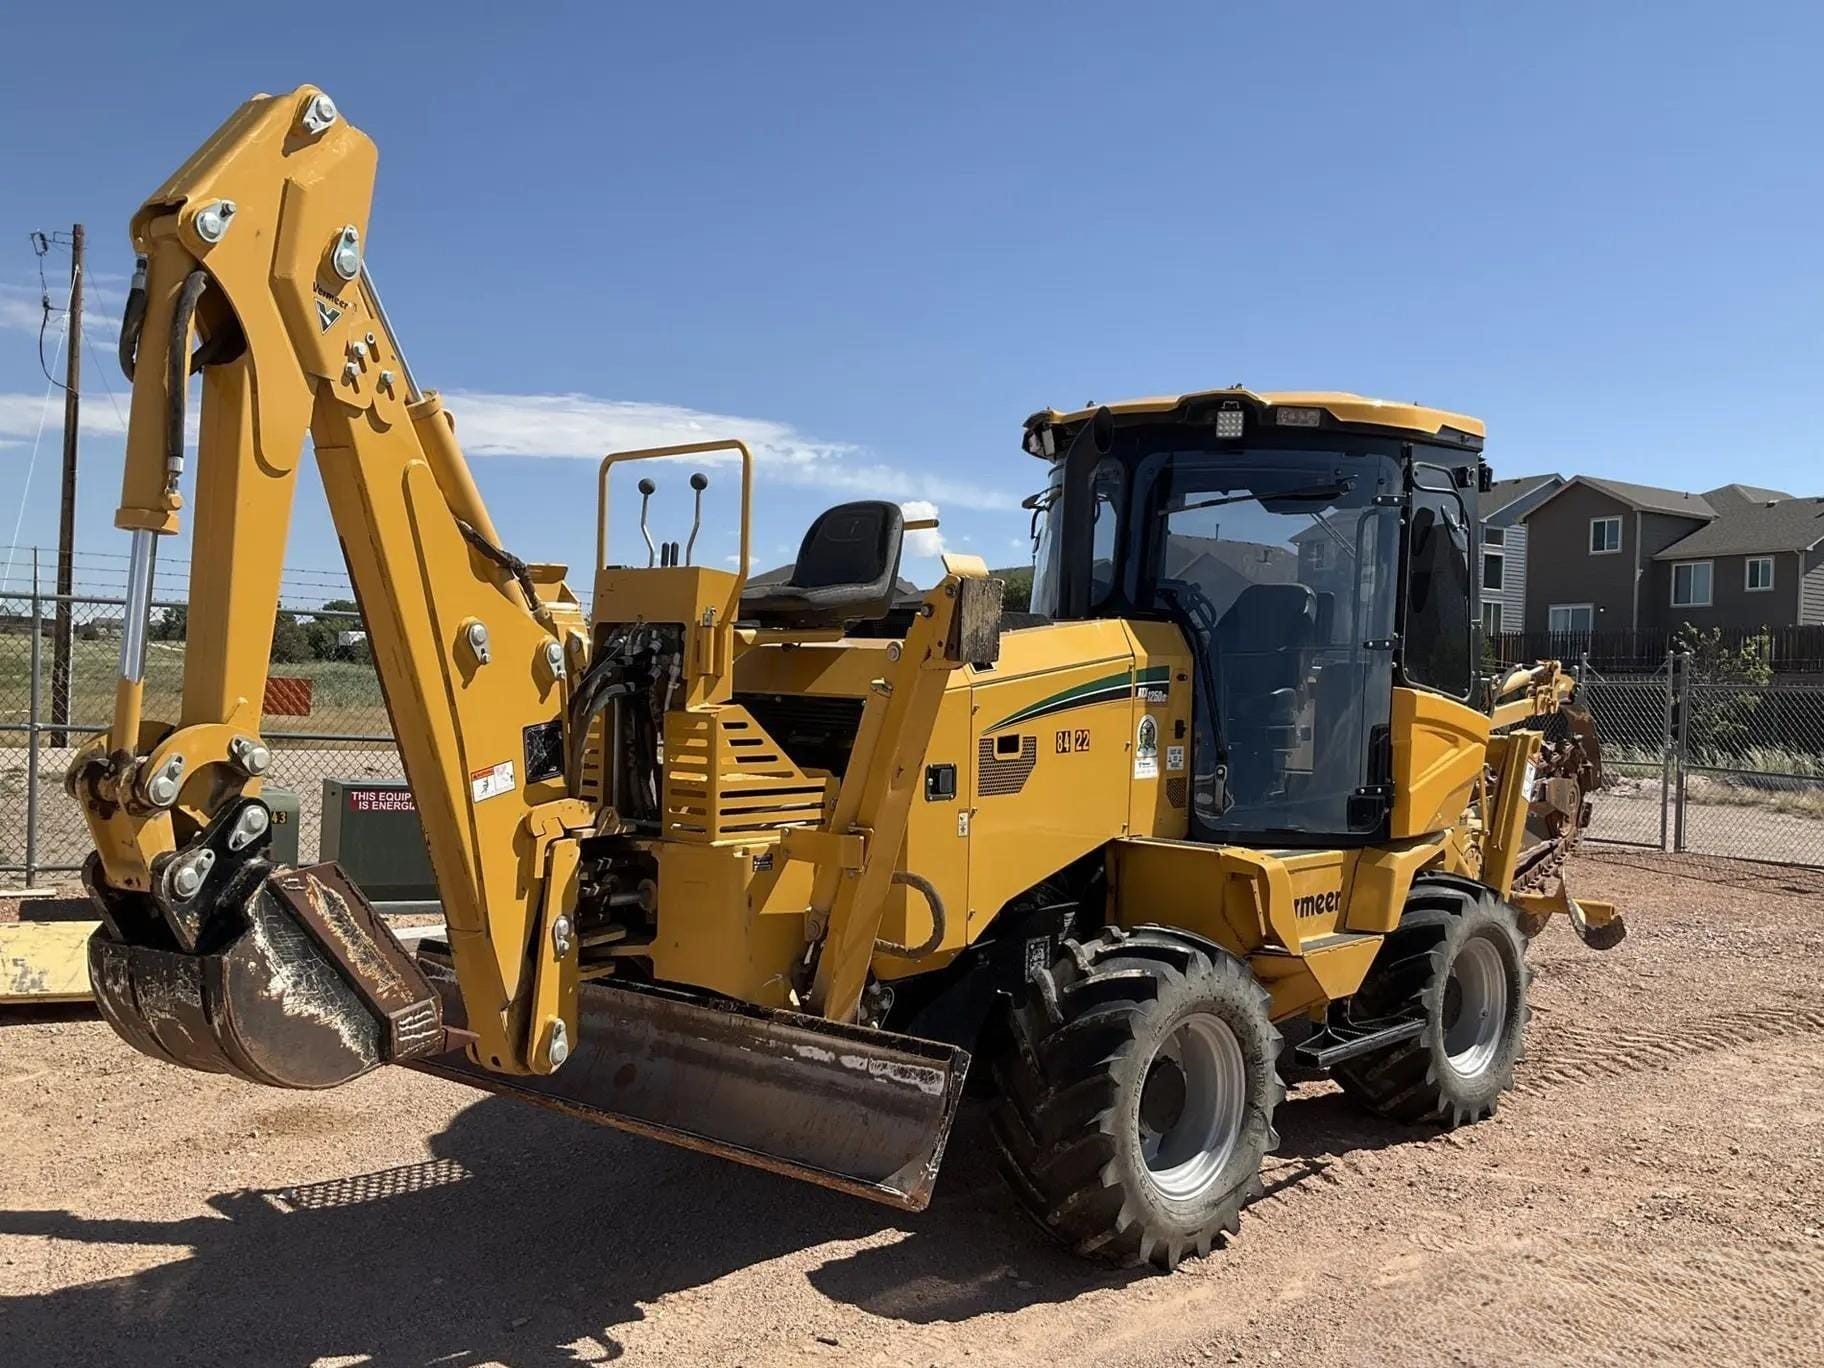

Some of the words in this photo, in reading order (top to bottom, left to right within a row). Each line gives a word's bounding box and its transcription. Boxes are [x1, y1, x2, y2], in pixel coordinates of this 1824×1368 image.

[312, 281, 349, 310] Vermeer
[1057, 732, 1070, 752] 84
[1075, 730, 1089, 751] 22
[351, 791, 376, 801] THIS
[358, 801, 369, 810] IS
[371, 801, 415, 810] ENERGI
